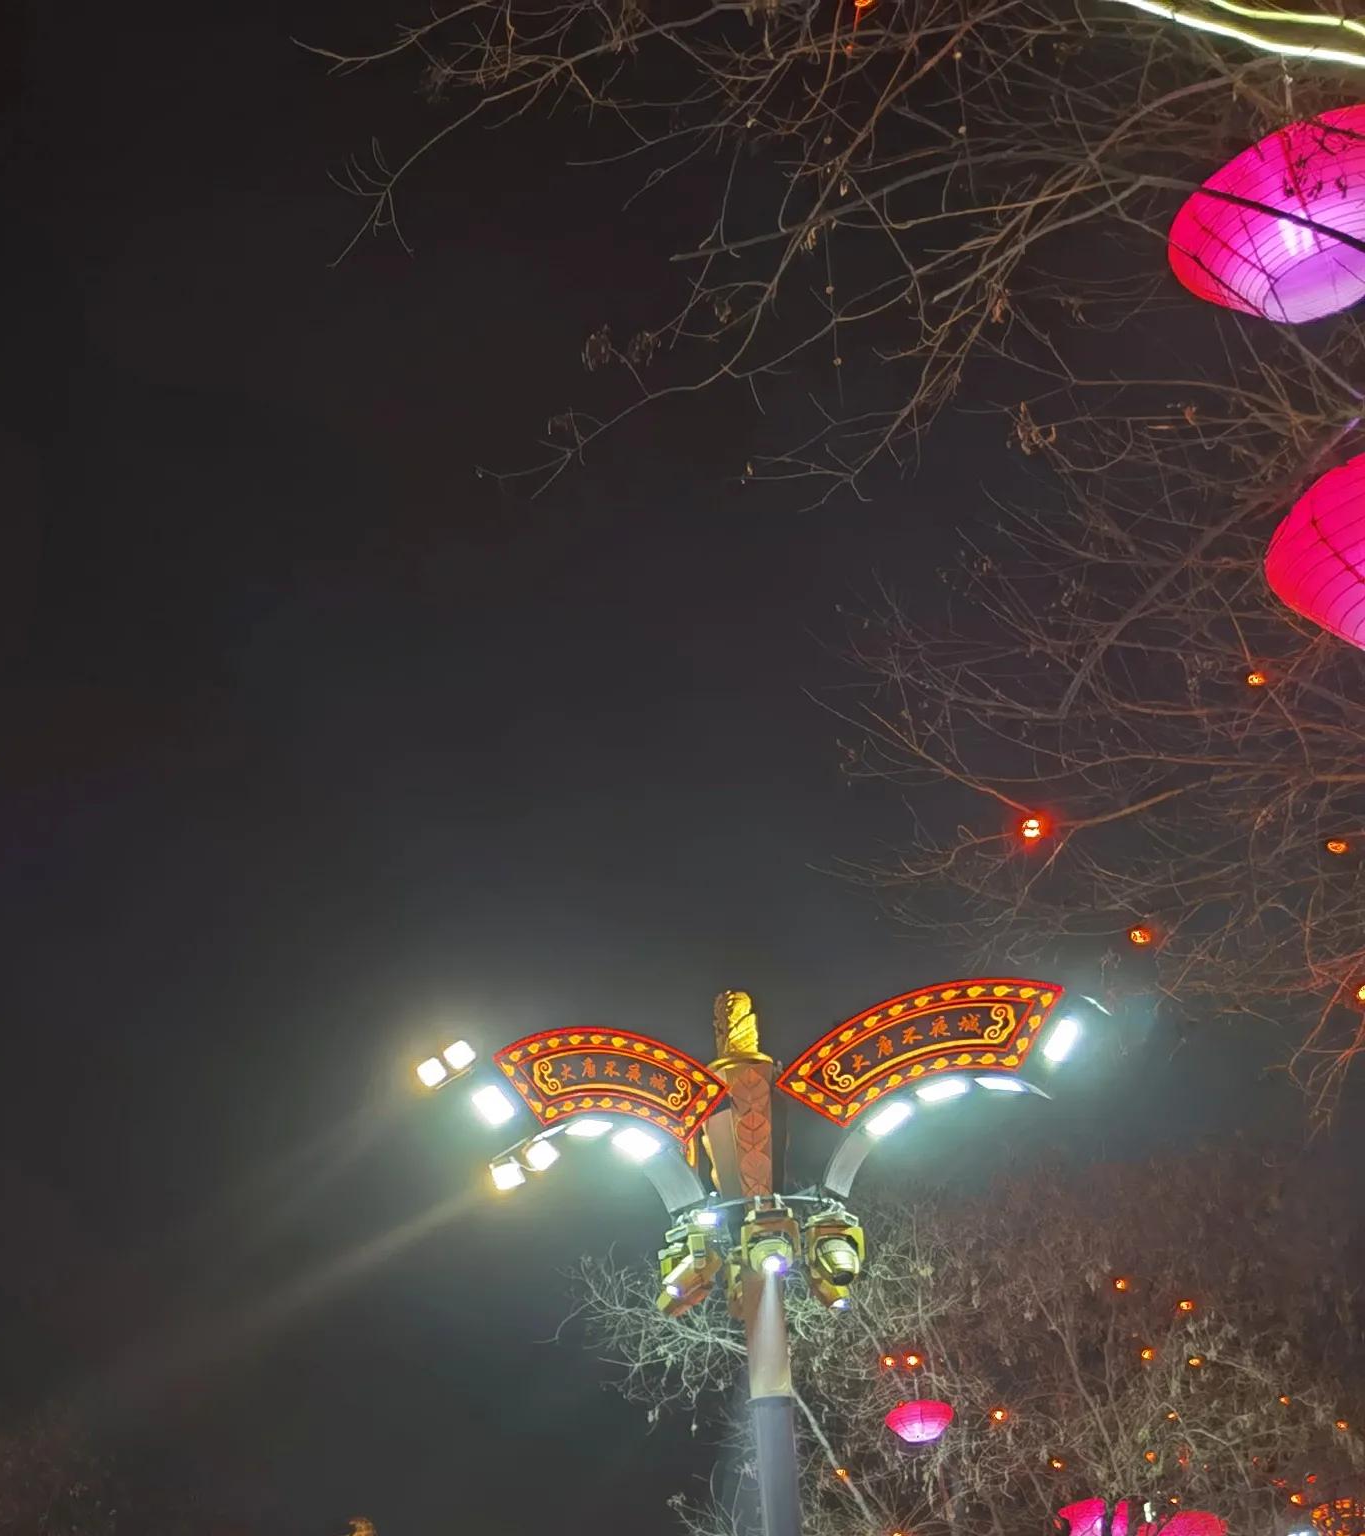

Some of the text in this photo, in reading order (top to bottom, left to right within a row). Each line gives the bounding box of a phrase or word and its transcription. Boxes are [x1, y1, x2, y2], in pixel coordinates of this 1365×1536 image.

[852, 1013, 982, 1072] 大唐不夜城
[560, 1056, 669, 1096] 大唐不夜城
